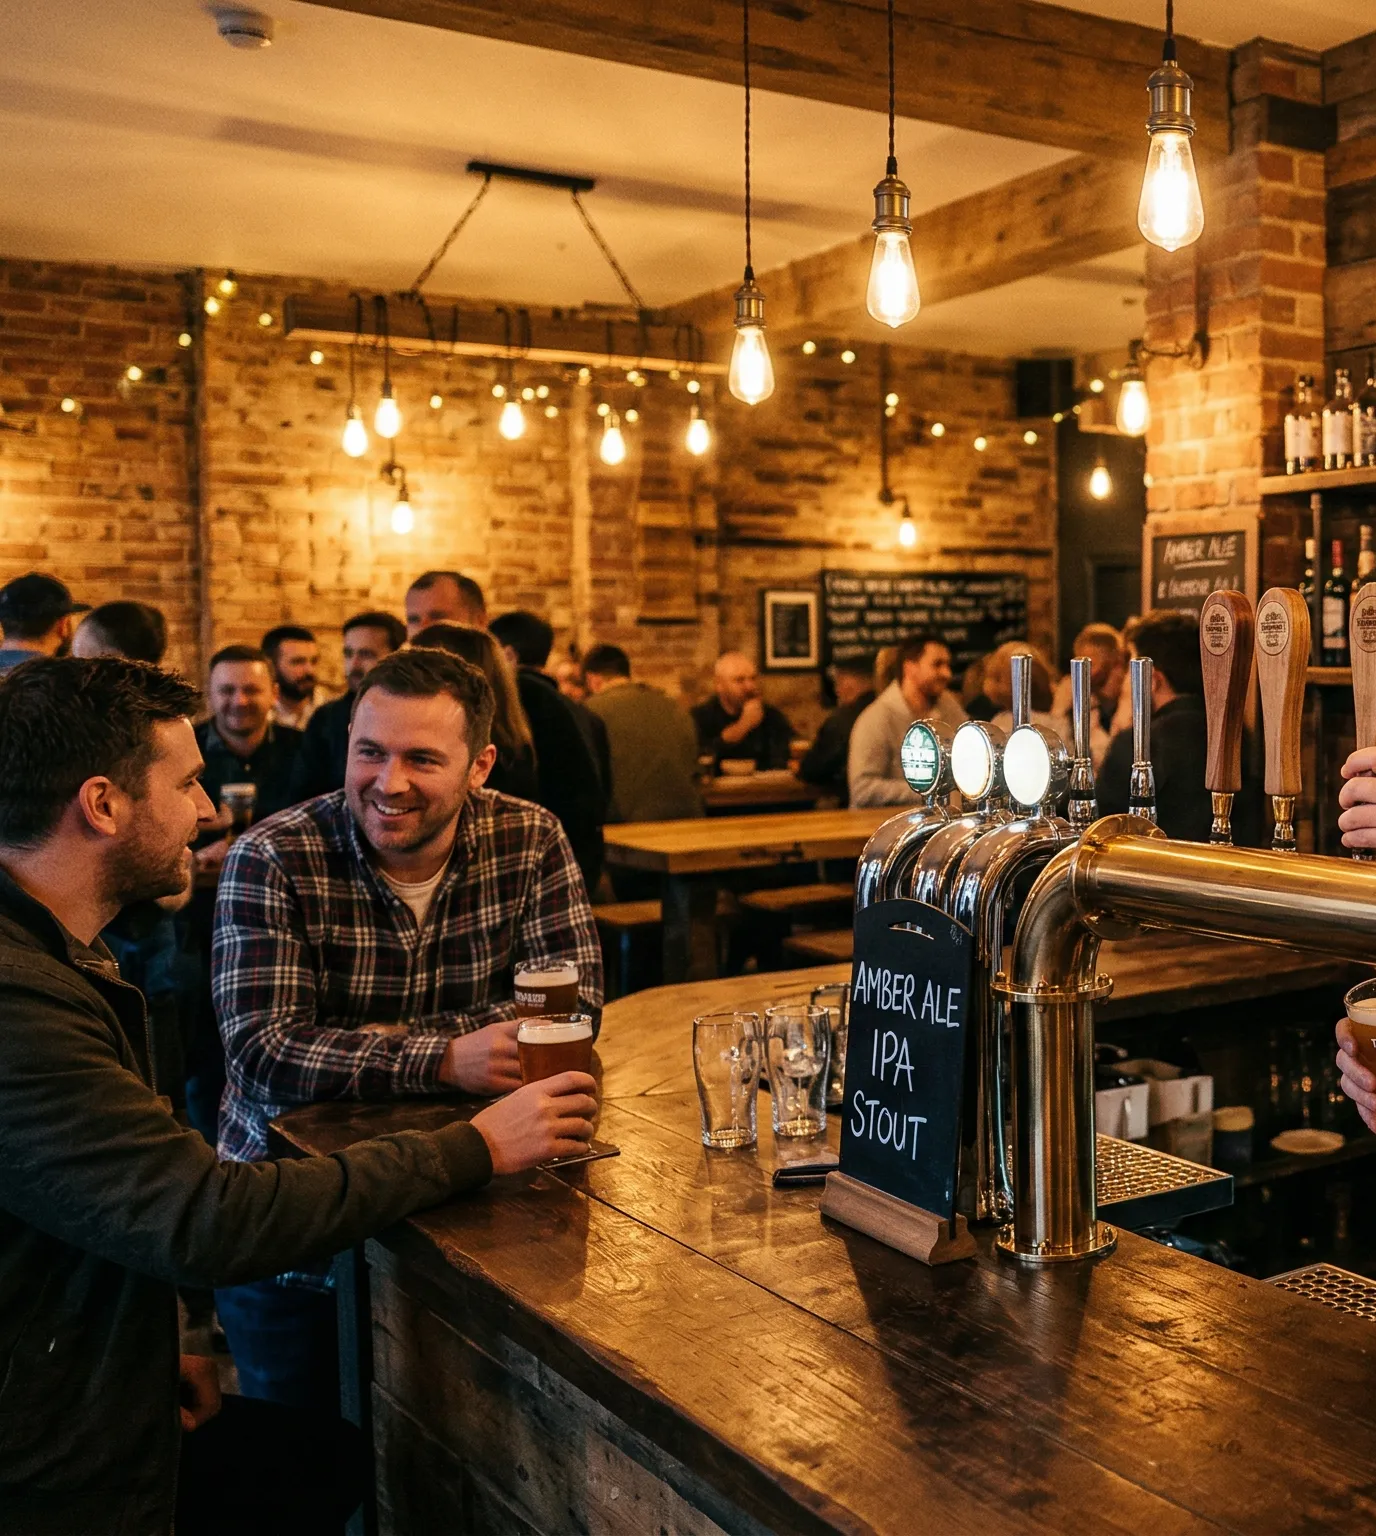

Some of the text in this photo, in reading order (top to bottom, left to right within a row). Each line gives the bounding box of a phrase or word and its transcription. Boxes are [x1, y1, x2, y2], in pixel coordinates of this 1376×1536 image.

[853, 961, 962, 1028] AMBER ALE
[872, 1028, 915, 1092] IPA
[851, 1090, 928, 1161] STOUT
